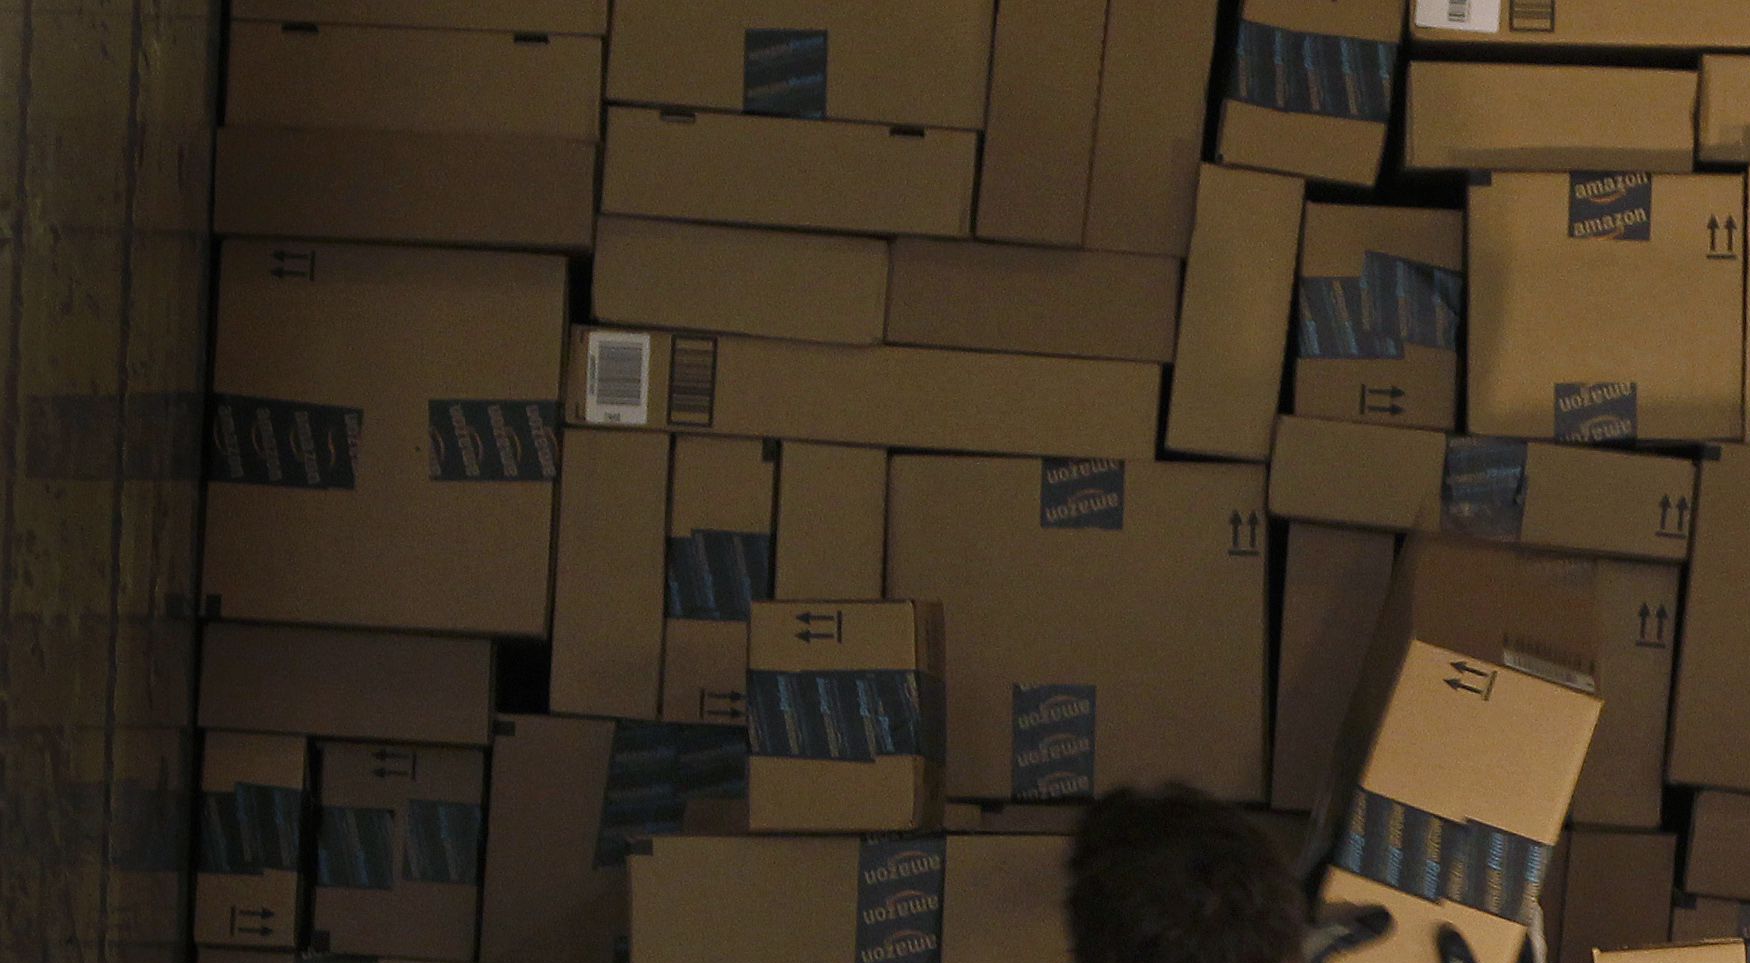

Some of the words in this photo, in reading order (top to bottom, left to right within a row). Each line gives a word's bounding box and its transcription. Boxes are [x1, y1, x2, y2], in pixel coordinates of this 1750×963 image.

[1574, 208, 1646, 236] amazon
[863, 855, 940, 884] amazon
[863, 896, 938, 925] amazon
[861, 934, 936, 963] amazon
